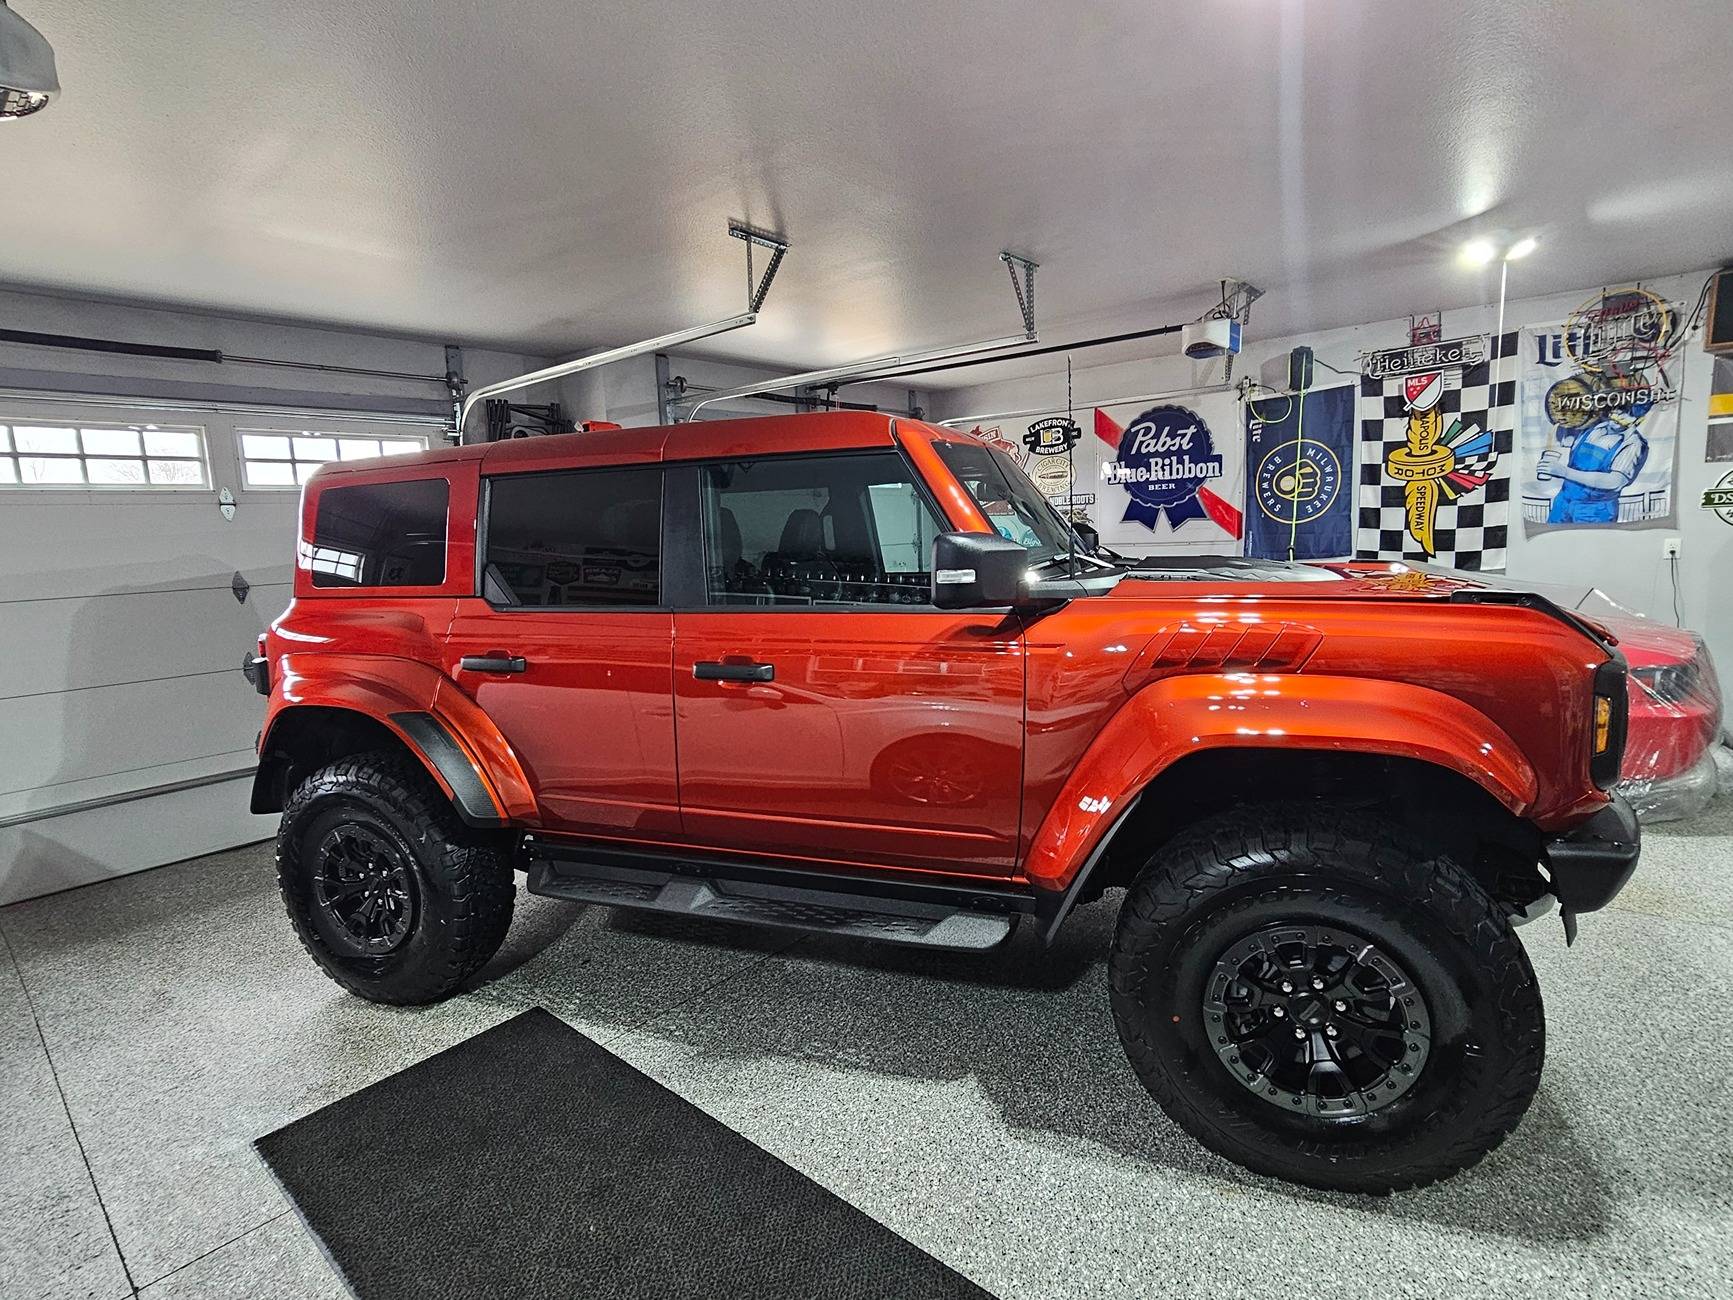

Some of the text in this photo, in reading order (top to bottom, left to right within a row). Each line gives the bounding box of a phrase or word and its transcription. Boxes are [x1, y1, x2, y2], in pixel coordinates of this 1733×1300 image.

[1407, 377, 1428, 387] MLS
[1558, 388, 1662, 411] WISCONSIN
[1130, 421, 1197, 454] Pabst
[1419, 411, 1430, 451] NAPOLIS
[1036, 443, 1068, 454] BREWERY
[1037, 458, 1069, 471] CIGAR CITY
[1149, 455, 1221, 481] Ribbon
[1393, 464, 1447, 478] MOTOR
[1148, 483, 1176, 491] BEER
[1261, 456, 1282, 512] BREWERS
[1306, 448, 1334, 513] MILWAUKEE
[1072, 494, 1094, 505] ROOTS
[1414, 485, 1427, 532] SPEEDWAY
